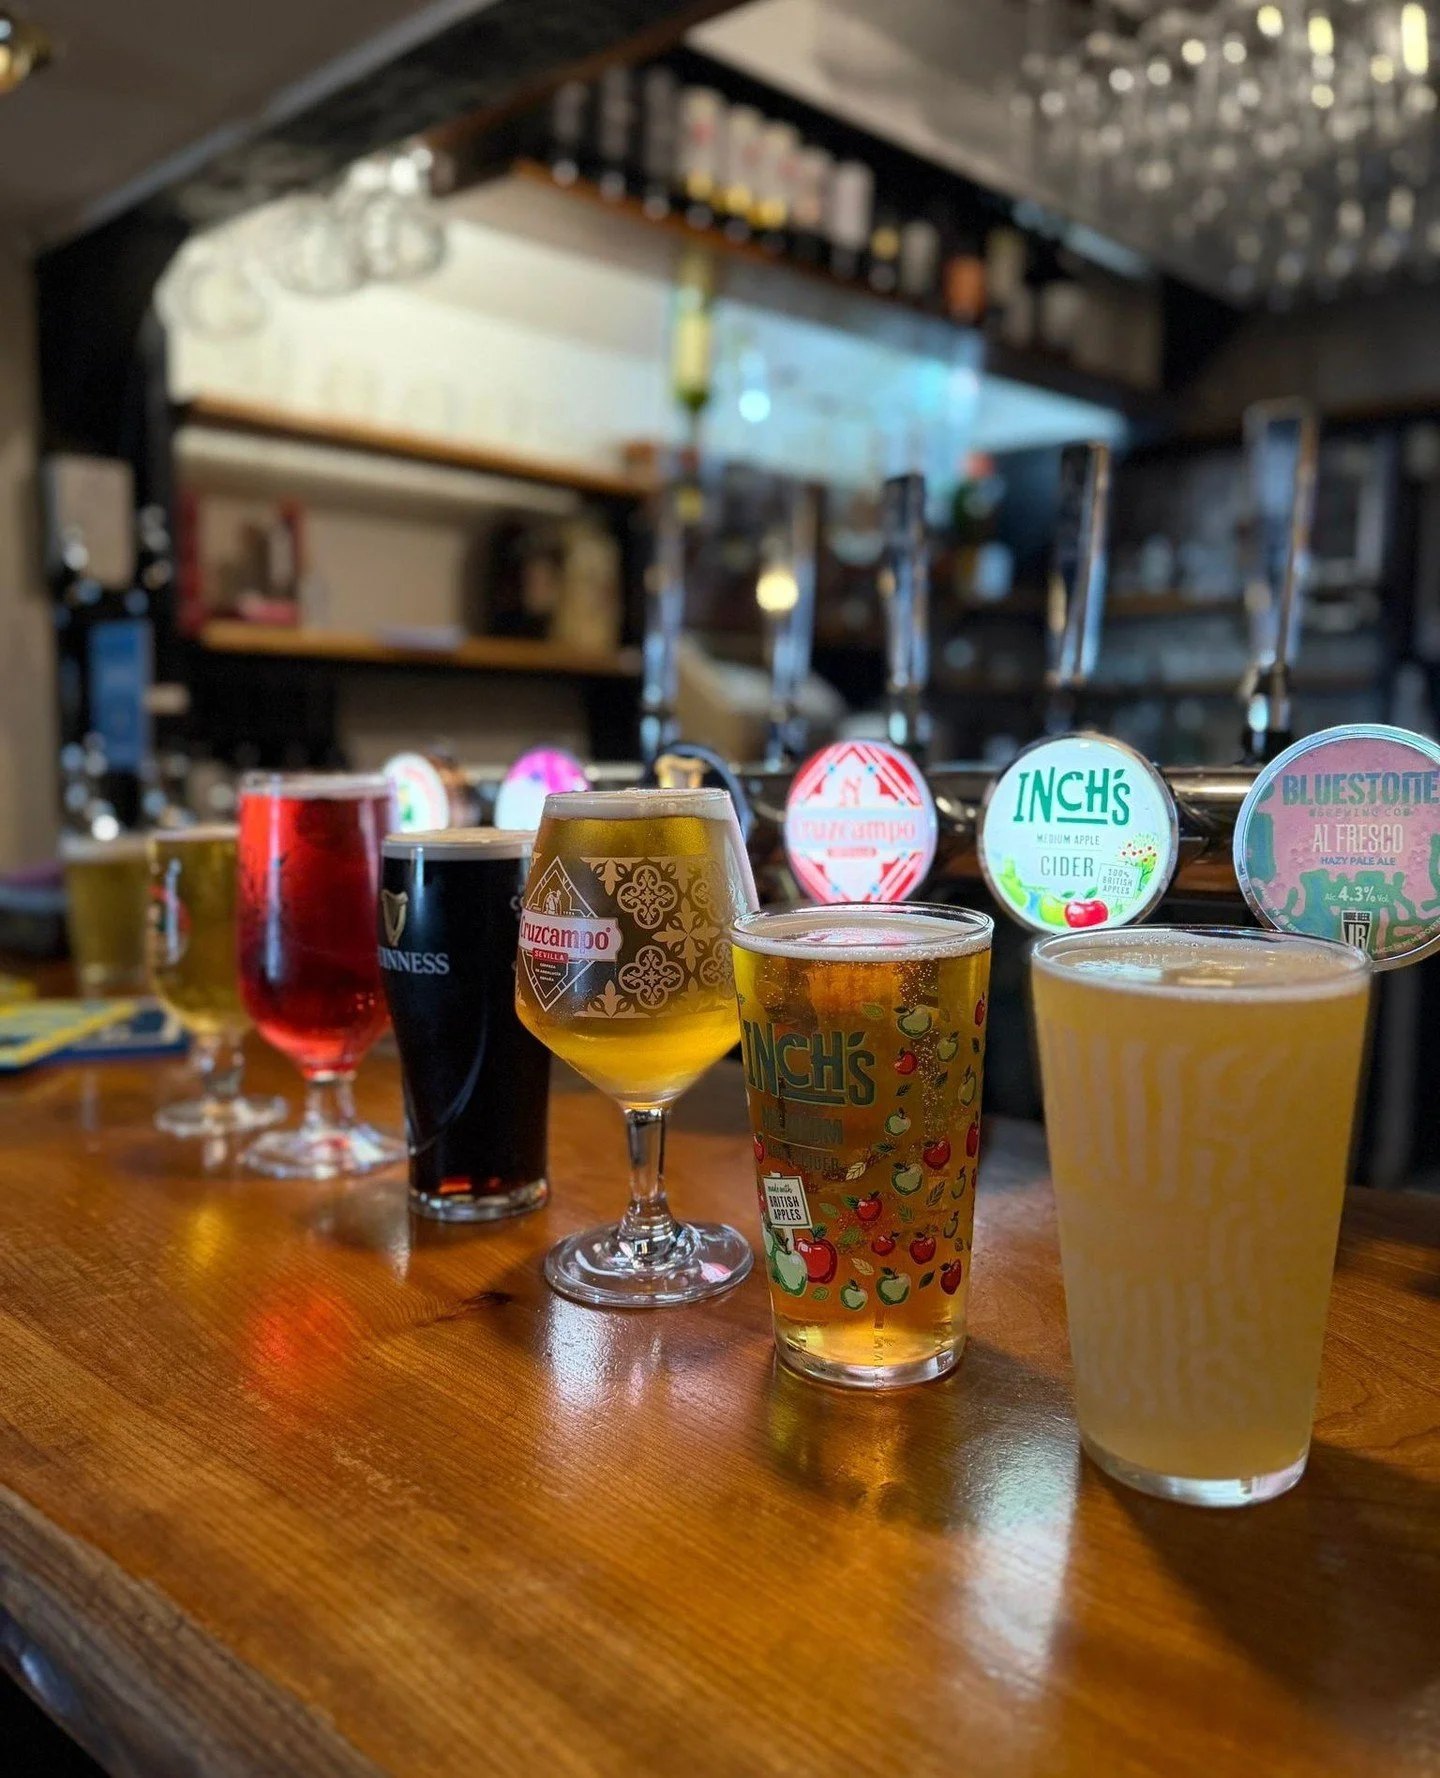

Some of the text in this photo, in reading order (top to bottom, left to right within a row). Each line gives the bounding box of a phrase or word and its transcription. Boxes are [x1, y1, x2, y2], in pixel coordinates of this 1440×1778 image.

[1036, 832, 1101, 846] MEDIUM APPLE
[1312, 823, 1404, 854] AL FRESCO
[1040, 855, 1094, 878] CIDER
[1320, 856, 1397, 866] HAZY PALE ALE
[1102, 875, 1133, 888] BRITISH
[1102, 884, 1130, 895] APPLES
[1337, 885, 1376, 902] 4.3%
[520, 915, 610, 953] Cruzcampo
[377, 946, 450, 975] INNESS
[533, 950, 566, 961] SEVILLA
[768, 1195, 800, 1209] BRITISH
[773, 1208, 802, 1221] APPLES
